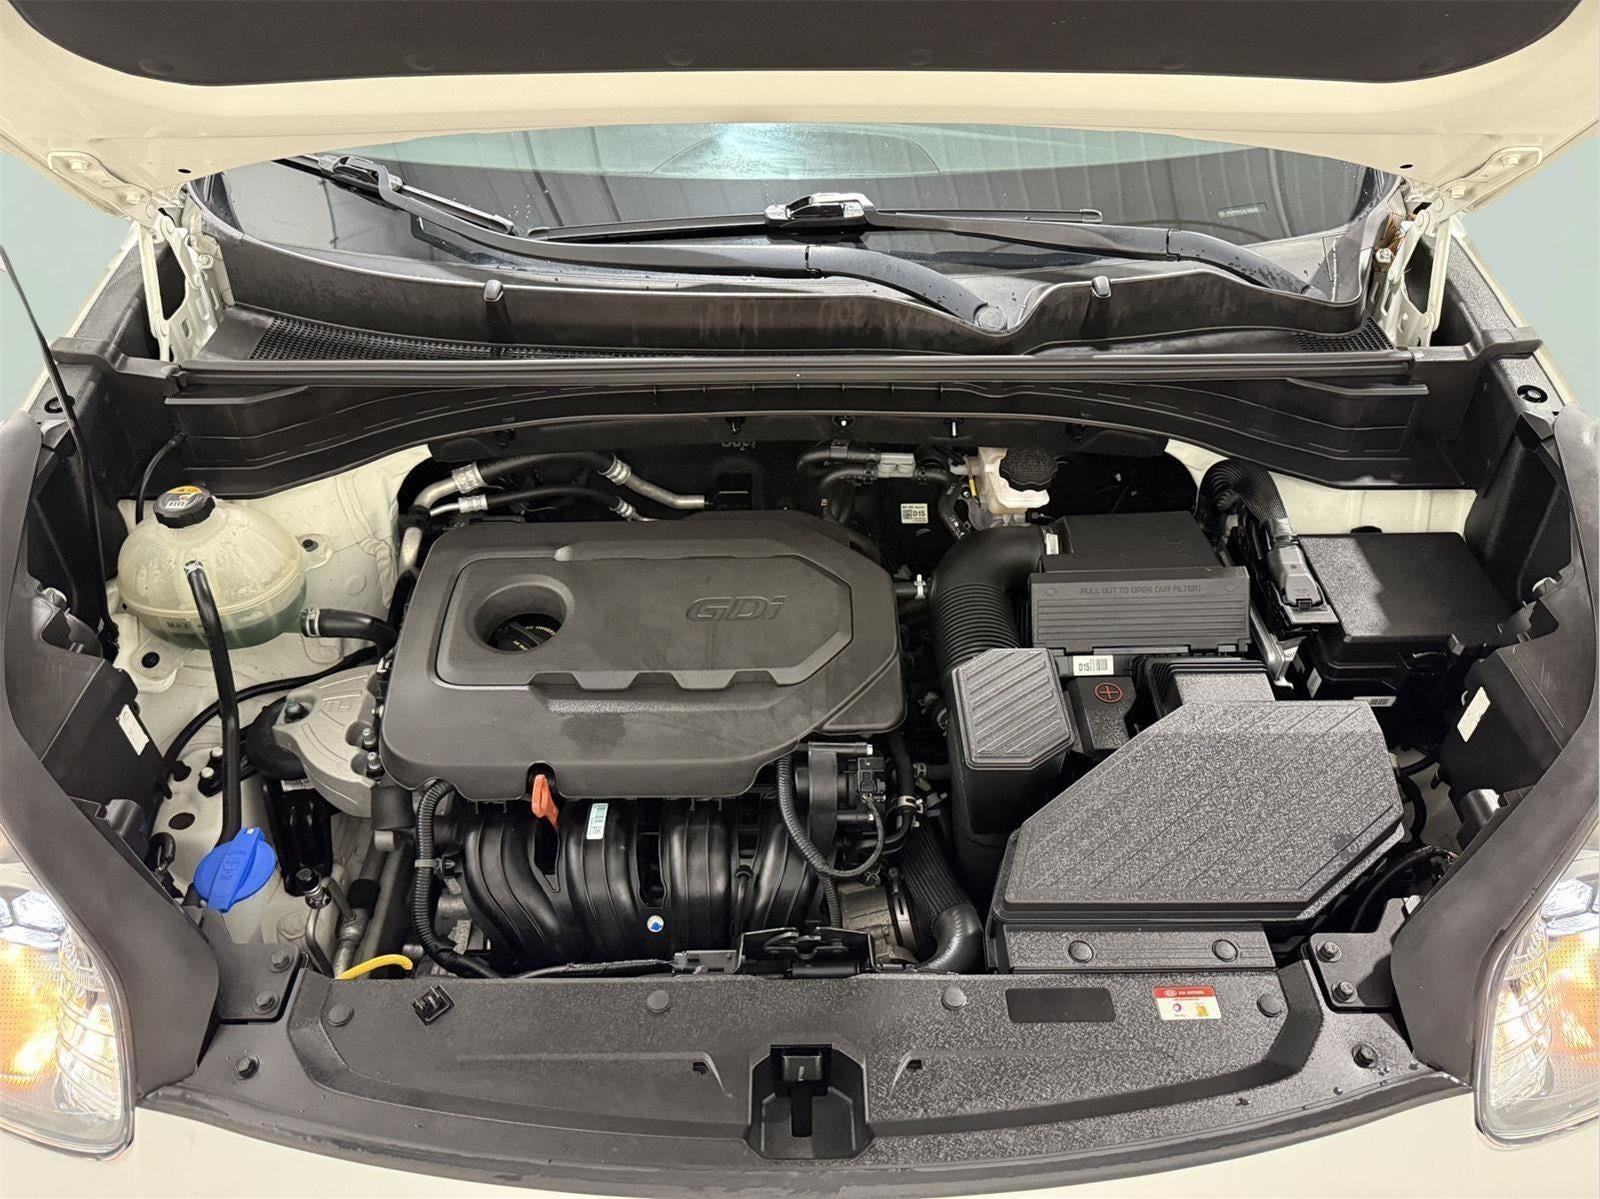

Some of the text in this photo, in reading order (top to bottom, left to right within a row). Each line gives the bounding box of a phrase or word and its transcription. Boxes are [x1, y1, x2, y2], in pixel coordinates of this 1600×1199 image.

[1101, 586, 1117, 594] OUT
[1117, 586, 1130, 594] TO
[1130, 585, 1153, 594] OPEN
